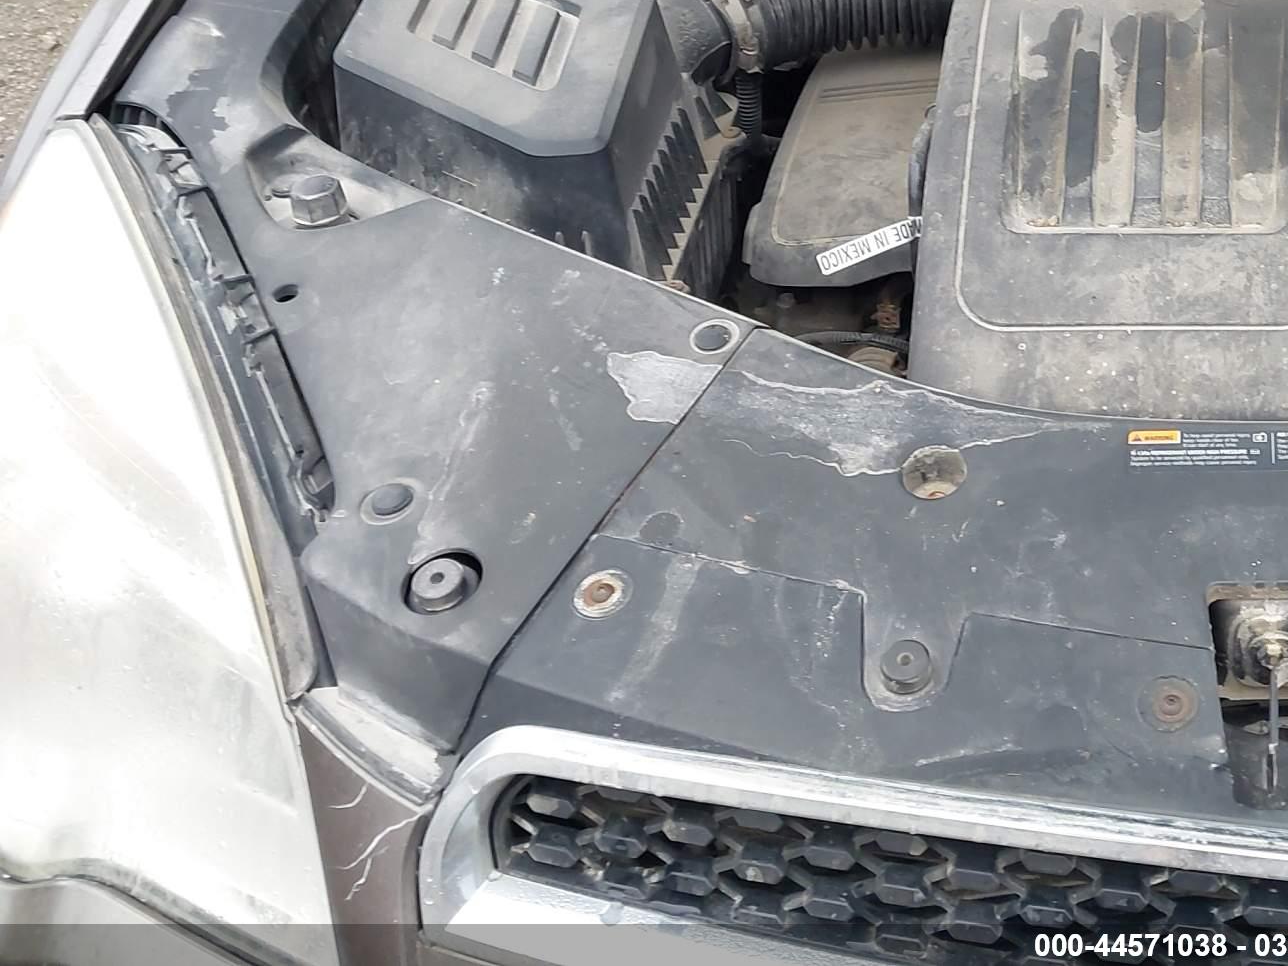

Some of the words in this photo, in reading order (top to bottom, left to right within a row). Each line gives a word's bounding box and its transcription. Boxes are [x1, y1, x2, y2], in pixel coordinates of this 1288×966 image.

[873, 231, 889, 249] IN
[892, 220, 922, 242] MADE
[821, 238, 871, 270] MEXICO
